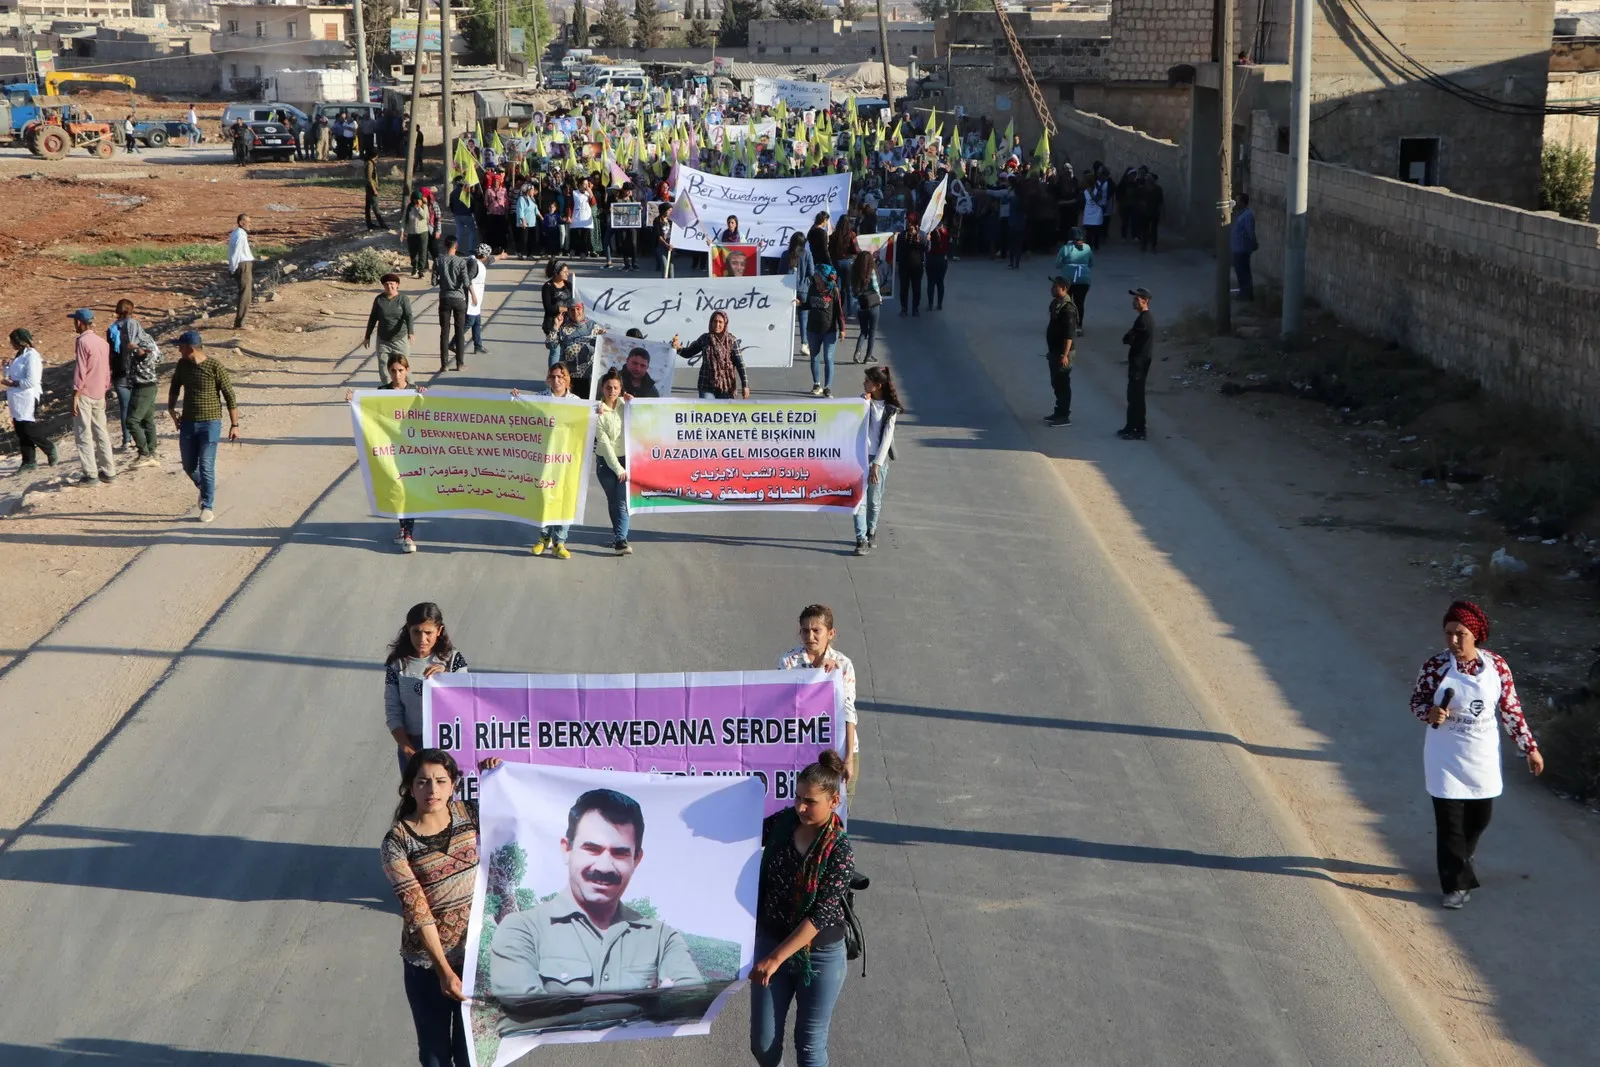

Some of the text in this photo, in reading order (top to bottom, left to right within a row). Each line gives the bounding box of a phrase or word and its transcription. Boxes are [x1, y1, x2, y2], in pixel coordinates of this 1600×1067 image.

[686, 172, 714, 197] Ber
[785, 185, 838, 214] Şengalê
[592, 287, 639, 312] Na
[695, 287, 773, 311] îxaneta
[433, 411, 506, 425] BERXWEDANA
[508, 415, 555, 428] ŞENGALÊ
[675, 409, 817, 424] BI ÎRADEYA GELÊ ÊZDÎ
[420, 428, 494, 442] BERXWEDANA
[677, 427, 815, 442] EMÊ ÎXANETÊ BIŞKÎNIN
[372, 445, 396, 456] EMÊ
[448, 445, 474, 456] GELÊ
[475, 447, 500, 457] XWE
[652, 444, 841, 459] Û AZADIYA GEL MISOGER BIKIN
[396, 466, 556, 489] بروح مقاومة شنكال ومقاومة العصر
[742, 467, 776, 480] الشعب
[436, 484, 526, 500] سنضمن حرية شعبنا
[685, 487, 713, 499] حرية
[717, 486, 765, 501] وسنحقق
[767, 485, 806, 500] الخيانة
[809, 483, 853, 499] سنحطم
[538, 718, 716, 748] BERXWEDANA
[722, 712, 831, 744] SERDEMÊ
